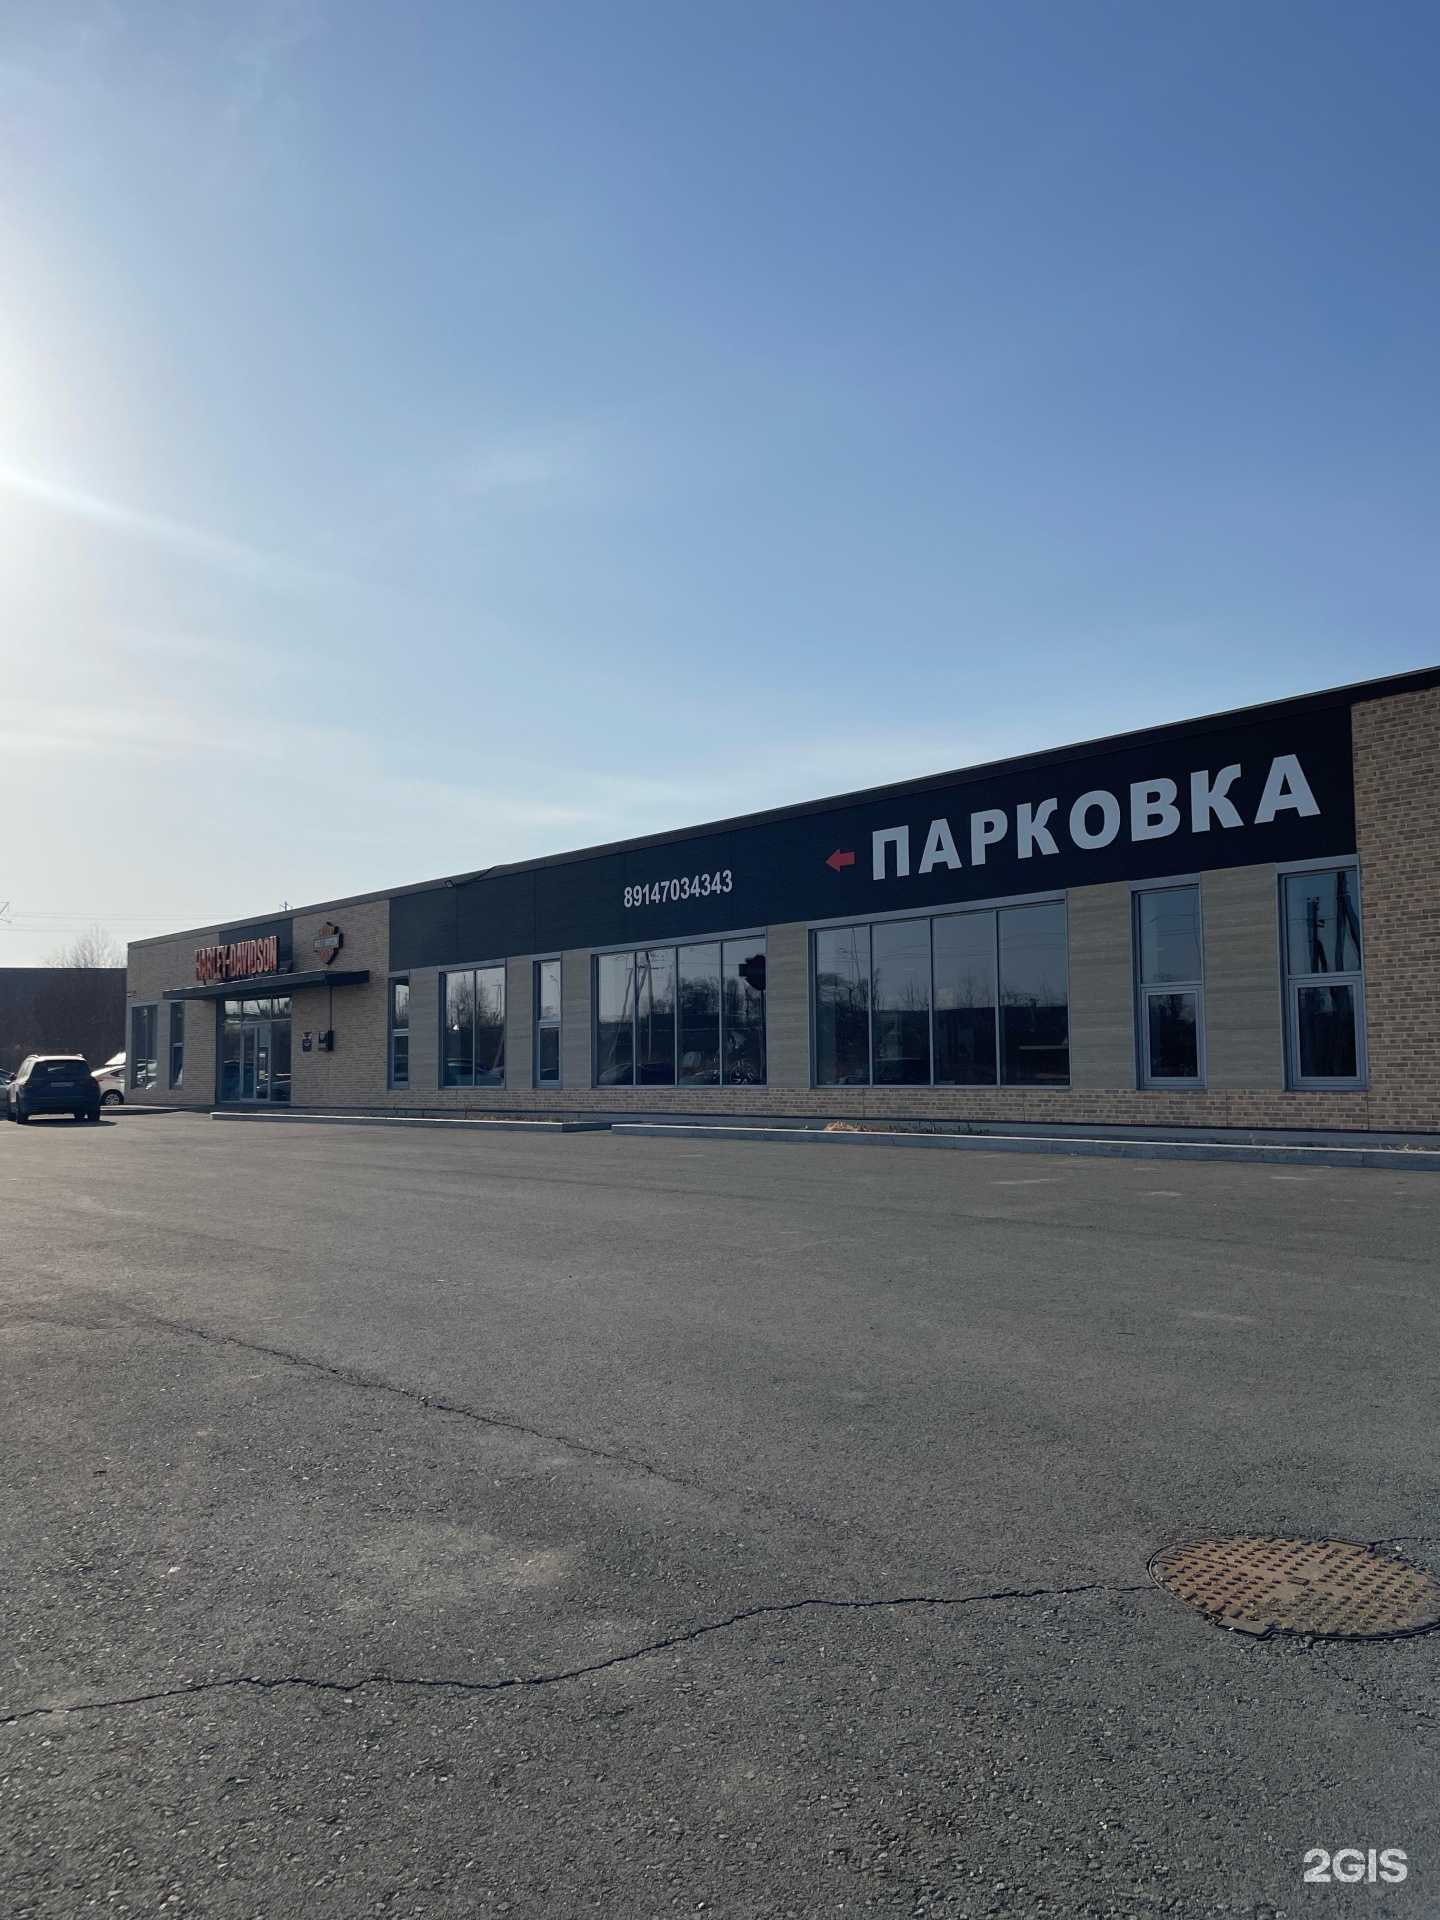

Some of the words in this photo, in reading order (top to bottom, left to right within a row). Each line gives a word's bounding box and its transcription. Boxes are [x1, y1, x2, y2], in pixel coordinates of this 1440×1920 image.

[872, 754, 1320, 881] ПАРКОВКА
[624, 869, 733, 908] 89147034343
[194, 935, 277, 981] HARLEY-DAVIDSON
